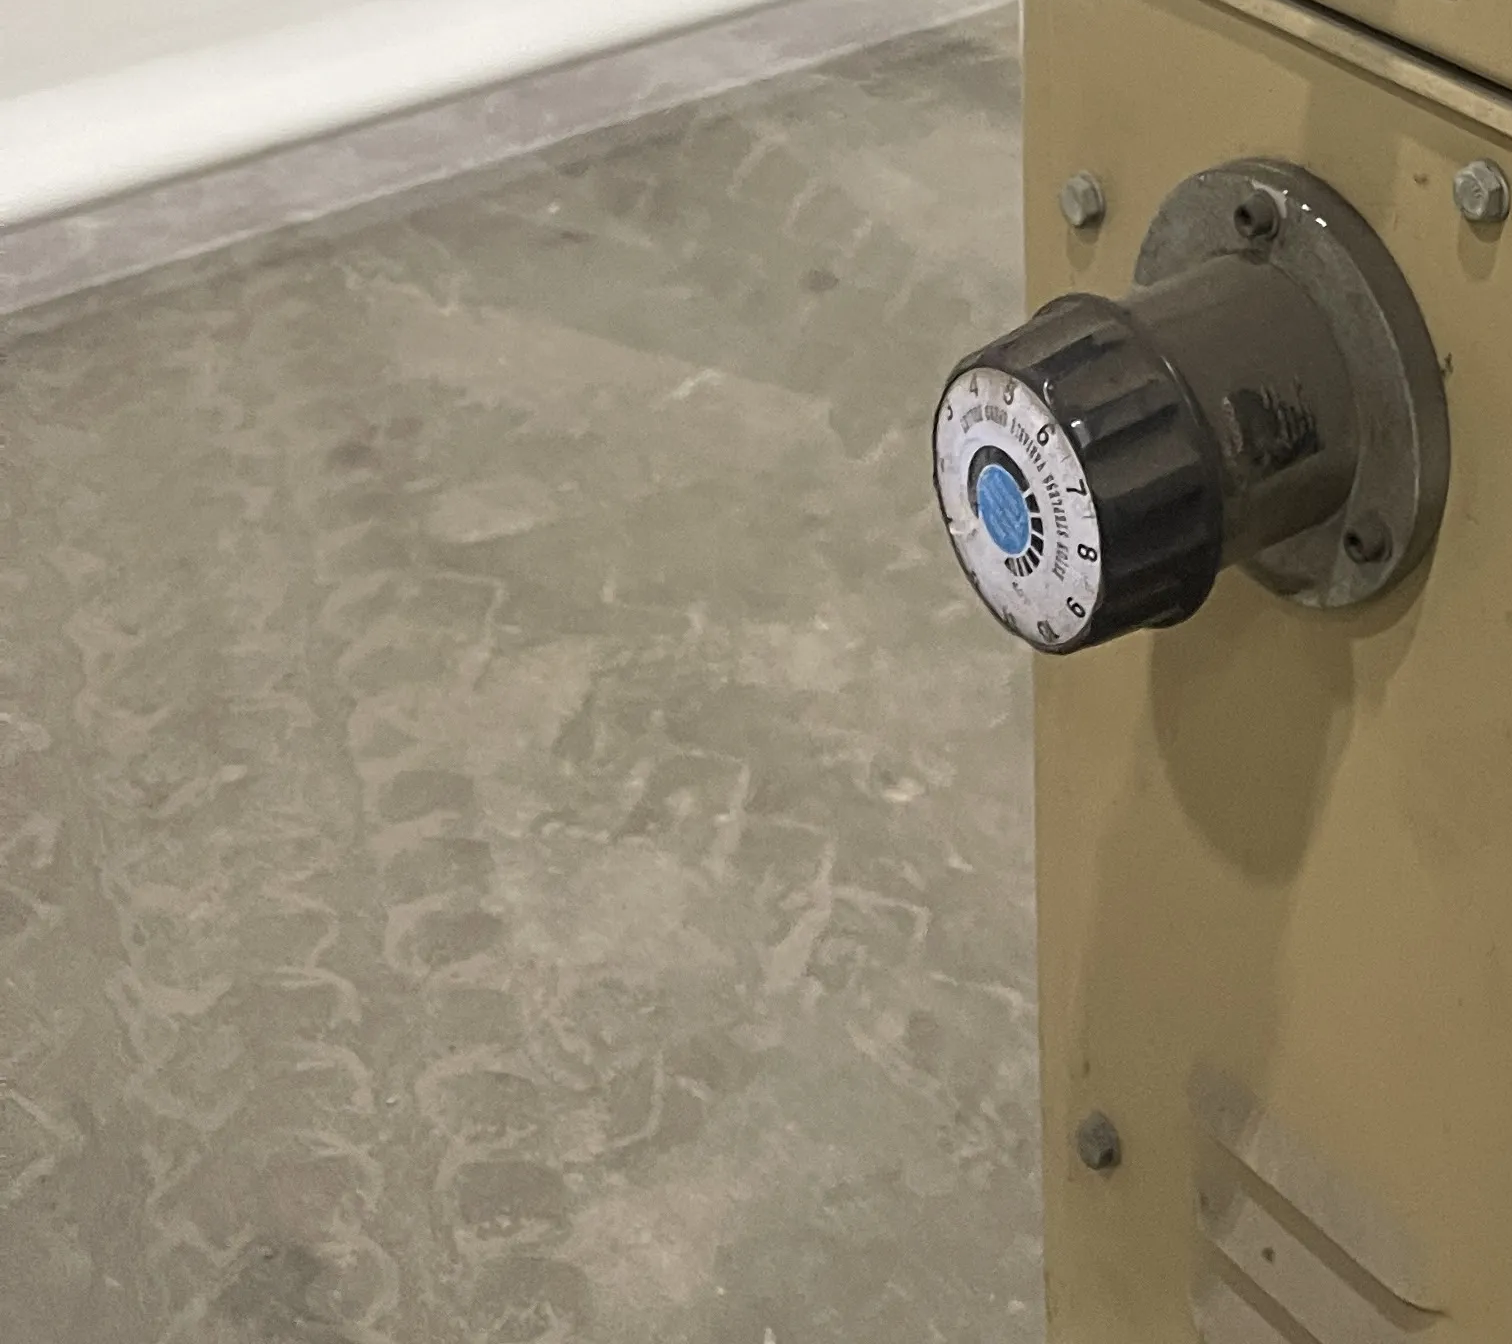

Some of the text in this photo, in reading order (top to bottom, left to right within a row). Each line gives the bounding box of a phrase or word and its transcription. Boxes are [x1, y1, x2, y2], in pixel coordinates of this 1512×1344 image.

[1036, 423, 1056, 447] 6
[1066, 478, 1087, 496] 7
[1077, 543, 1098, 562] 8
[1066, 596, 1086, 618] 9
